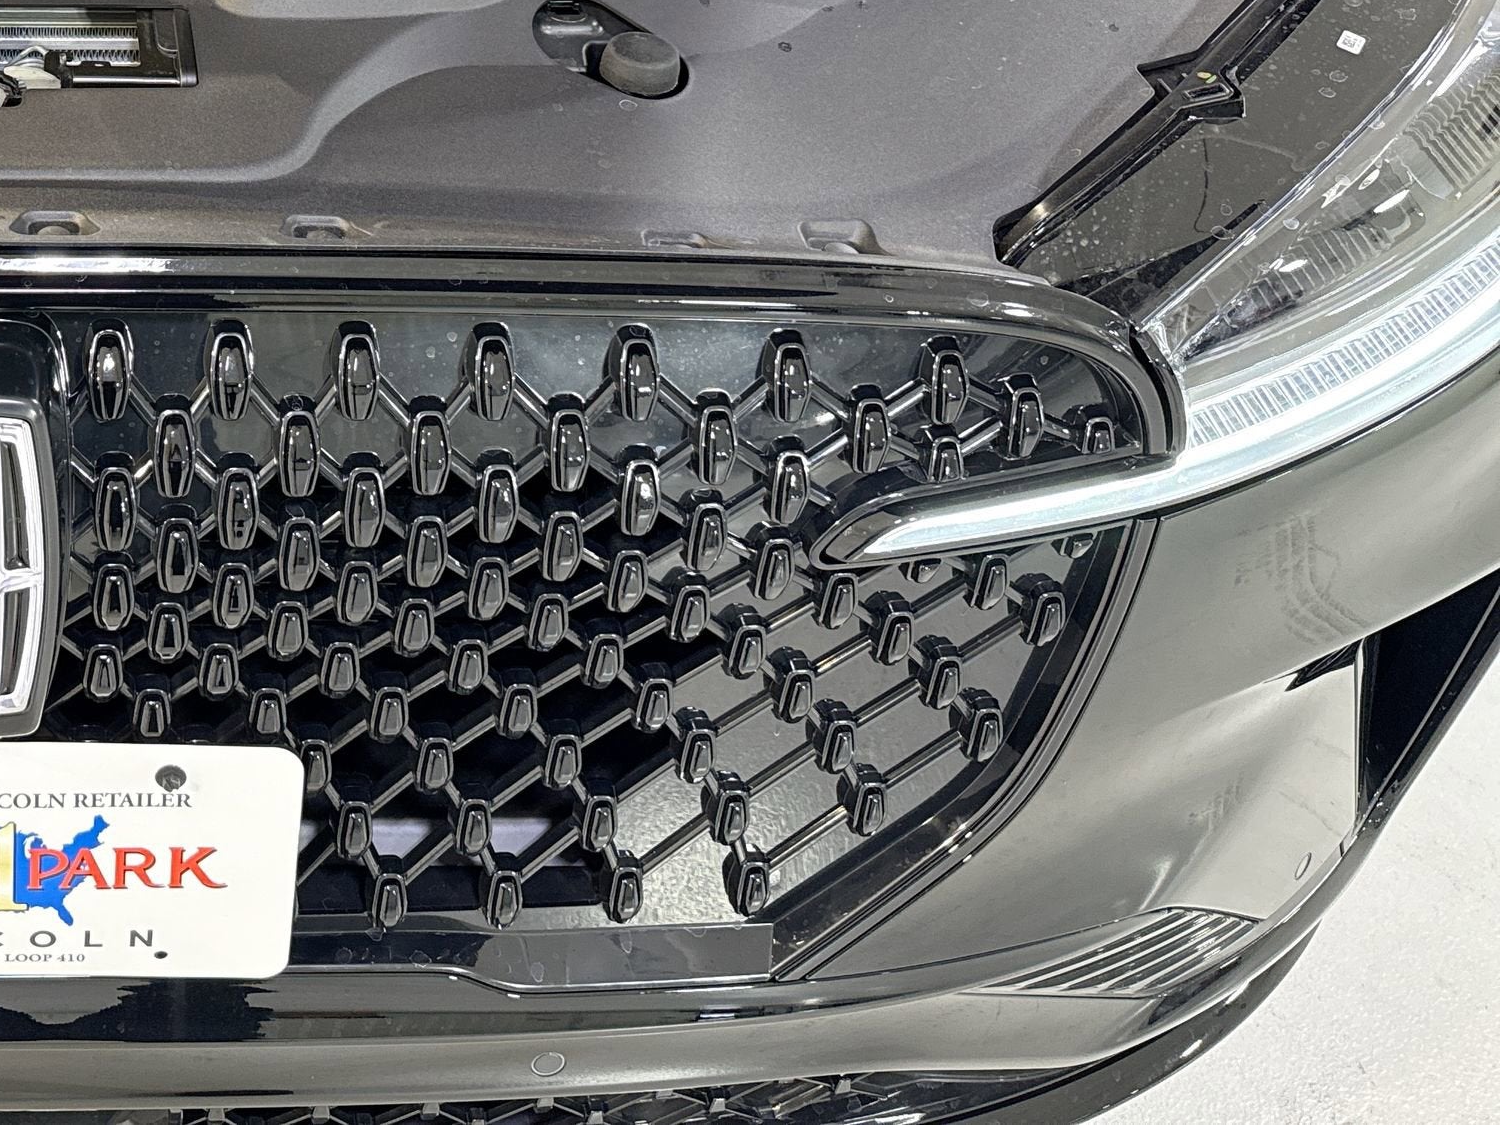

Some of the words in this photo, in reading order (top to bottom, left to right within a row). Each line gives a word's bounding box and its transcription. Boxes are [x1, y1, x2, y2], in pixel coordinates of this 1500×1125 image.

[73, 792, 193, 809] RETAILER
[28, 846, 228, 891] PARK
[4, 953, 53, 963] LOOP
[56, 953, 86, 964] 410
